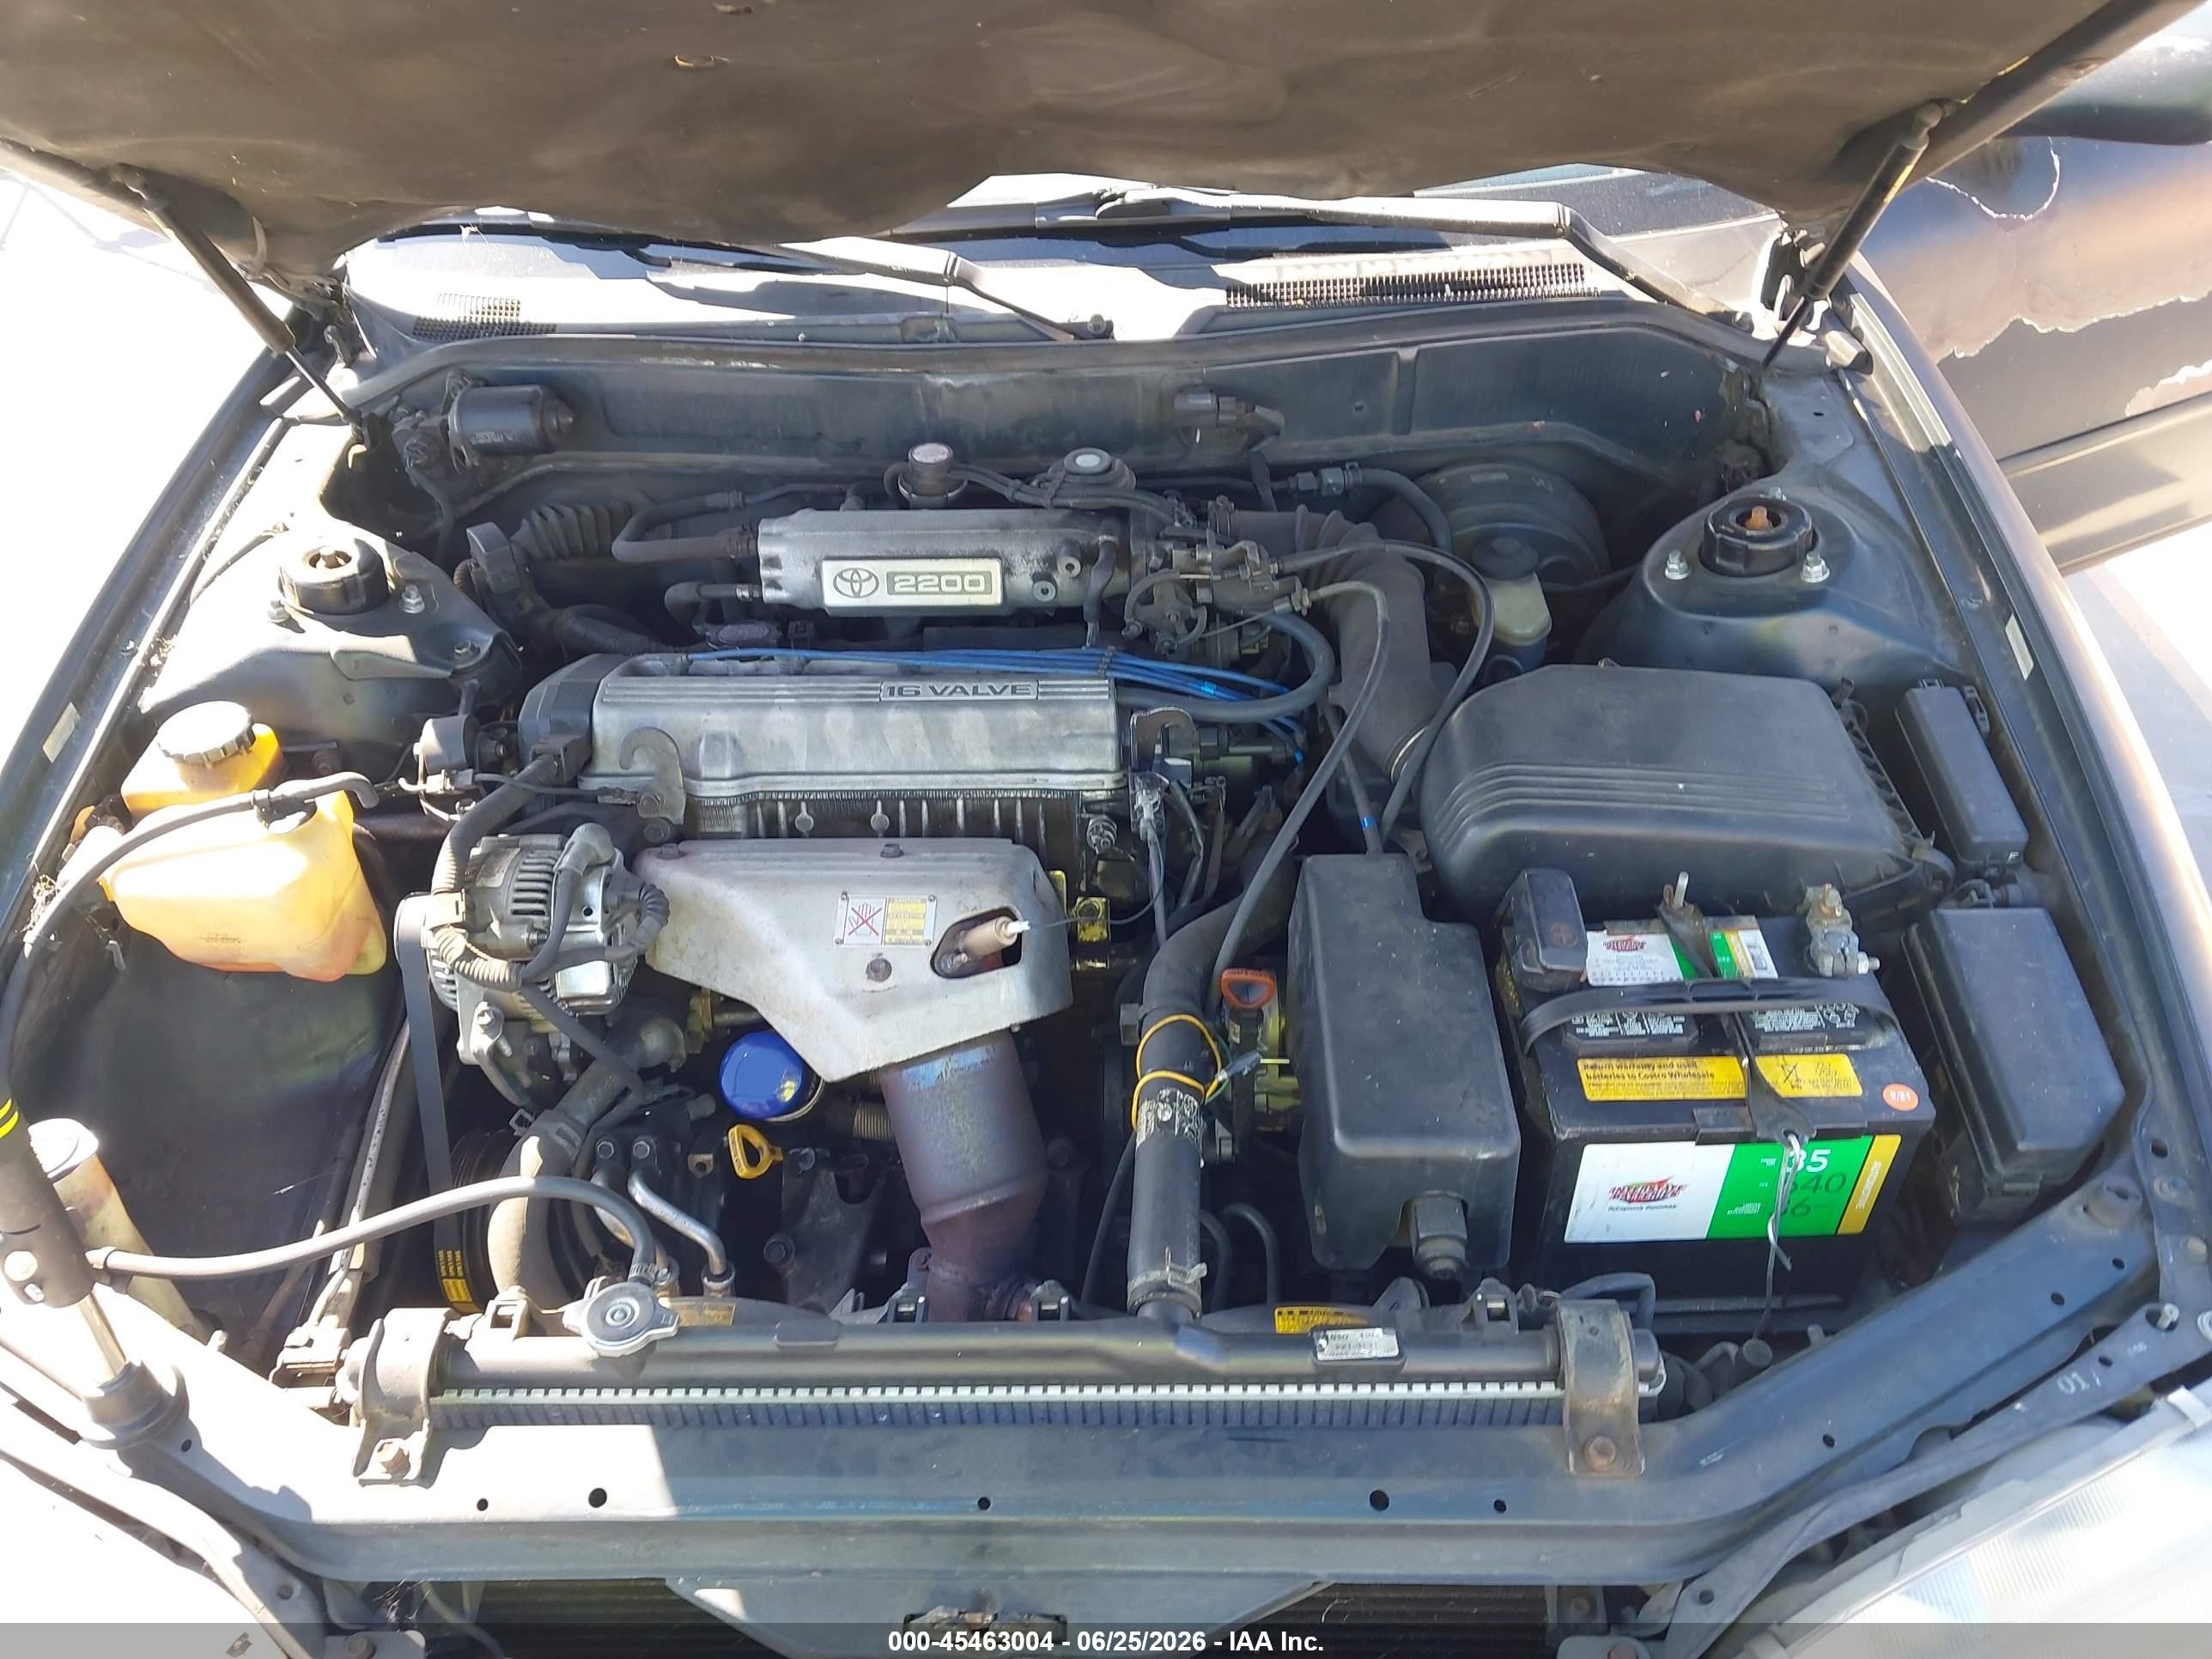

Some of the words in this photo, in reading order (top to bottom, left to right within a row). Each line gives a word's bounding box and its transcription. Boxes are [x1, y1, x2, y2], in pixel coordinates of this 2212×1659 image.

[893, 573, 987, 592] 2200
[887, 685, 921, 697] 16
[928, 684, 1030, 696] VALVE
